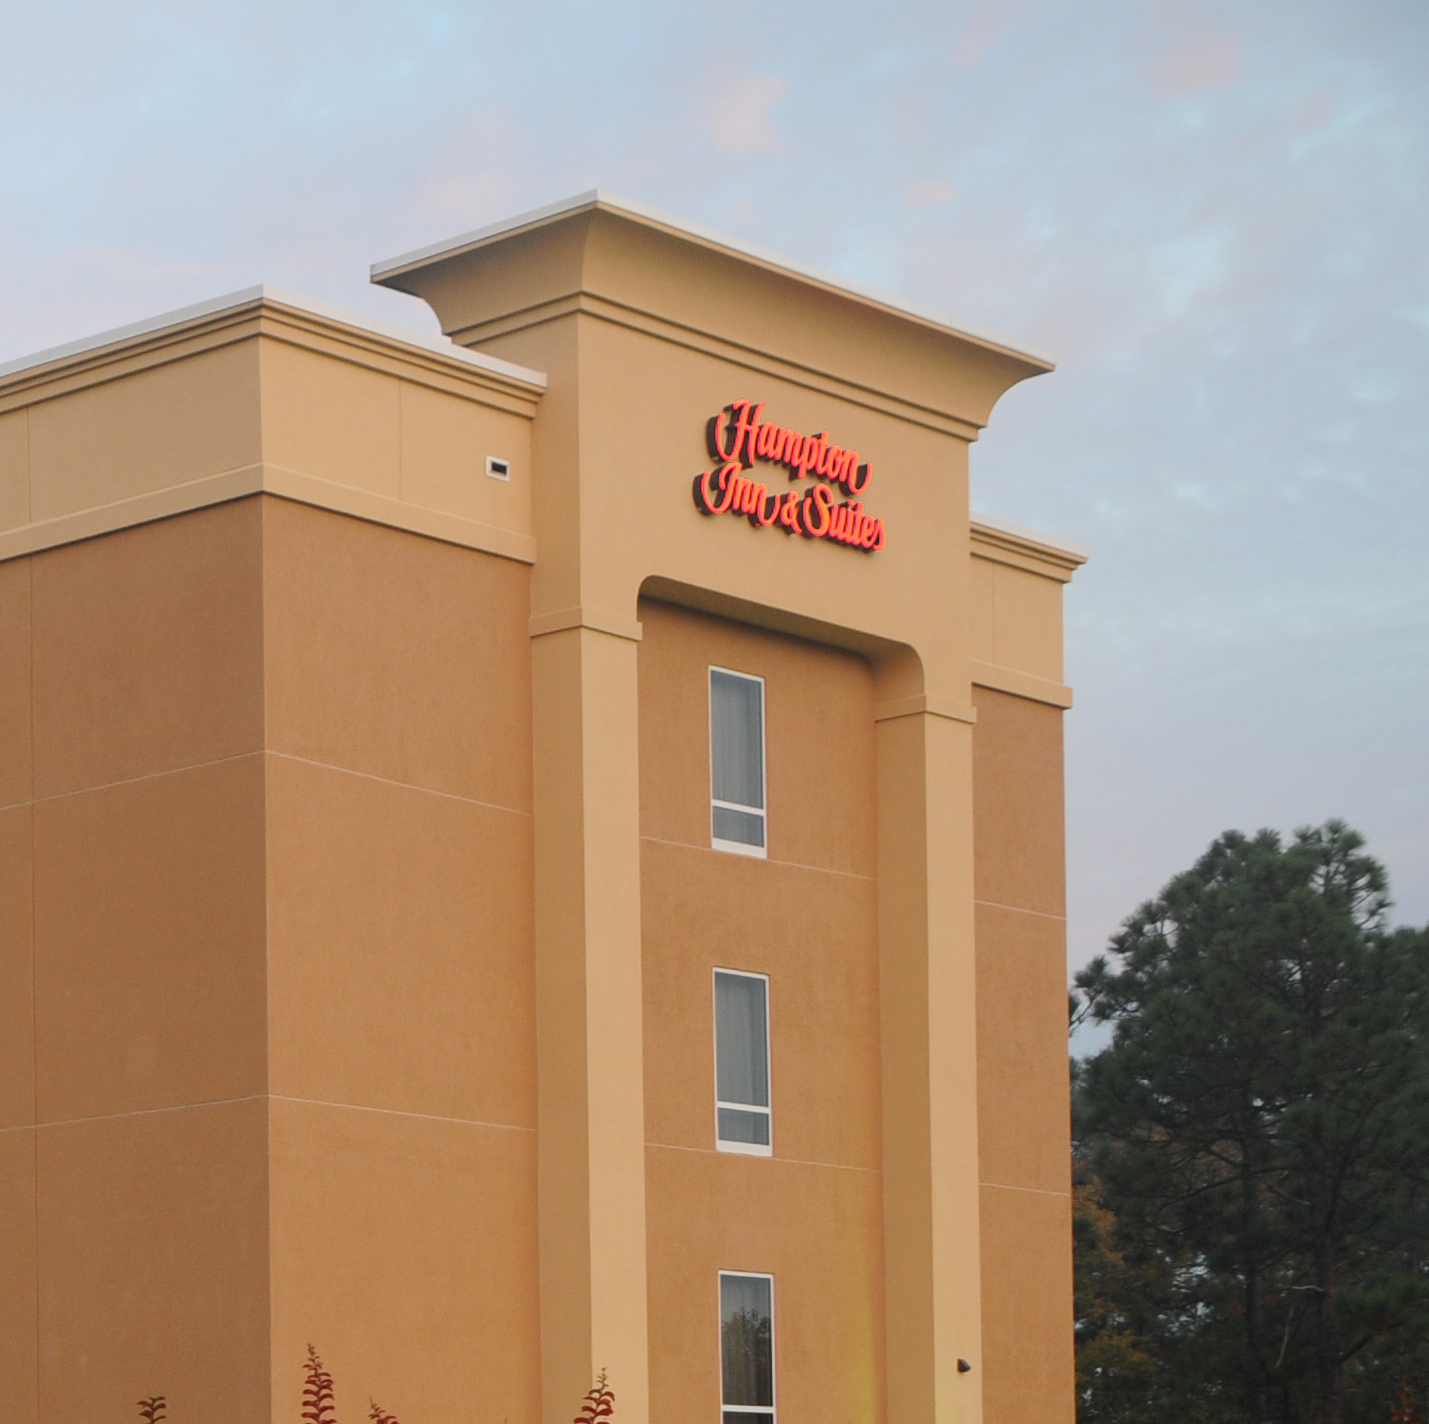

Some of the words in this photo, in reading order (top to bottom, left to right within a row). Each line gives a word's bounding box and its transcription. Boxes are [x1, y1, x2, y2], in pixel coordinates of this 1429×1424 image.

[711, 399, 873, 495] Hampton
[697, 461, 781, 527] Inn
[780, 490, 804, 534] &
[802, 482, 887, 552] Suites
